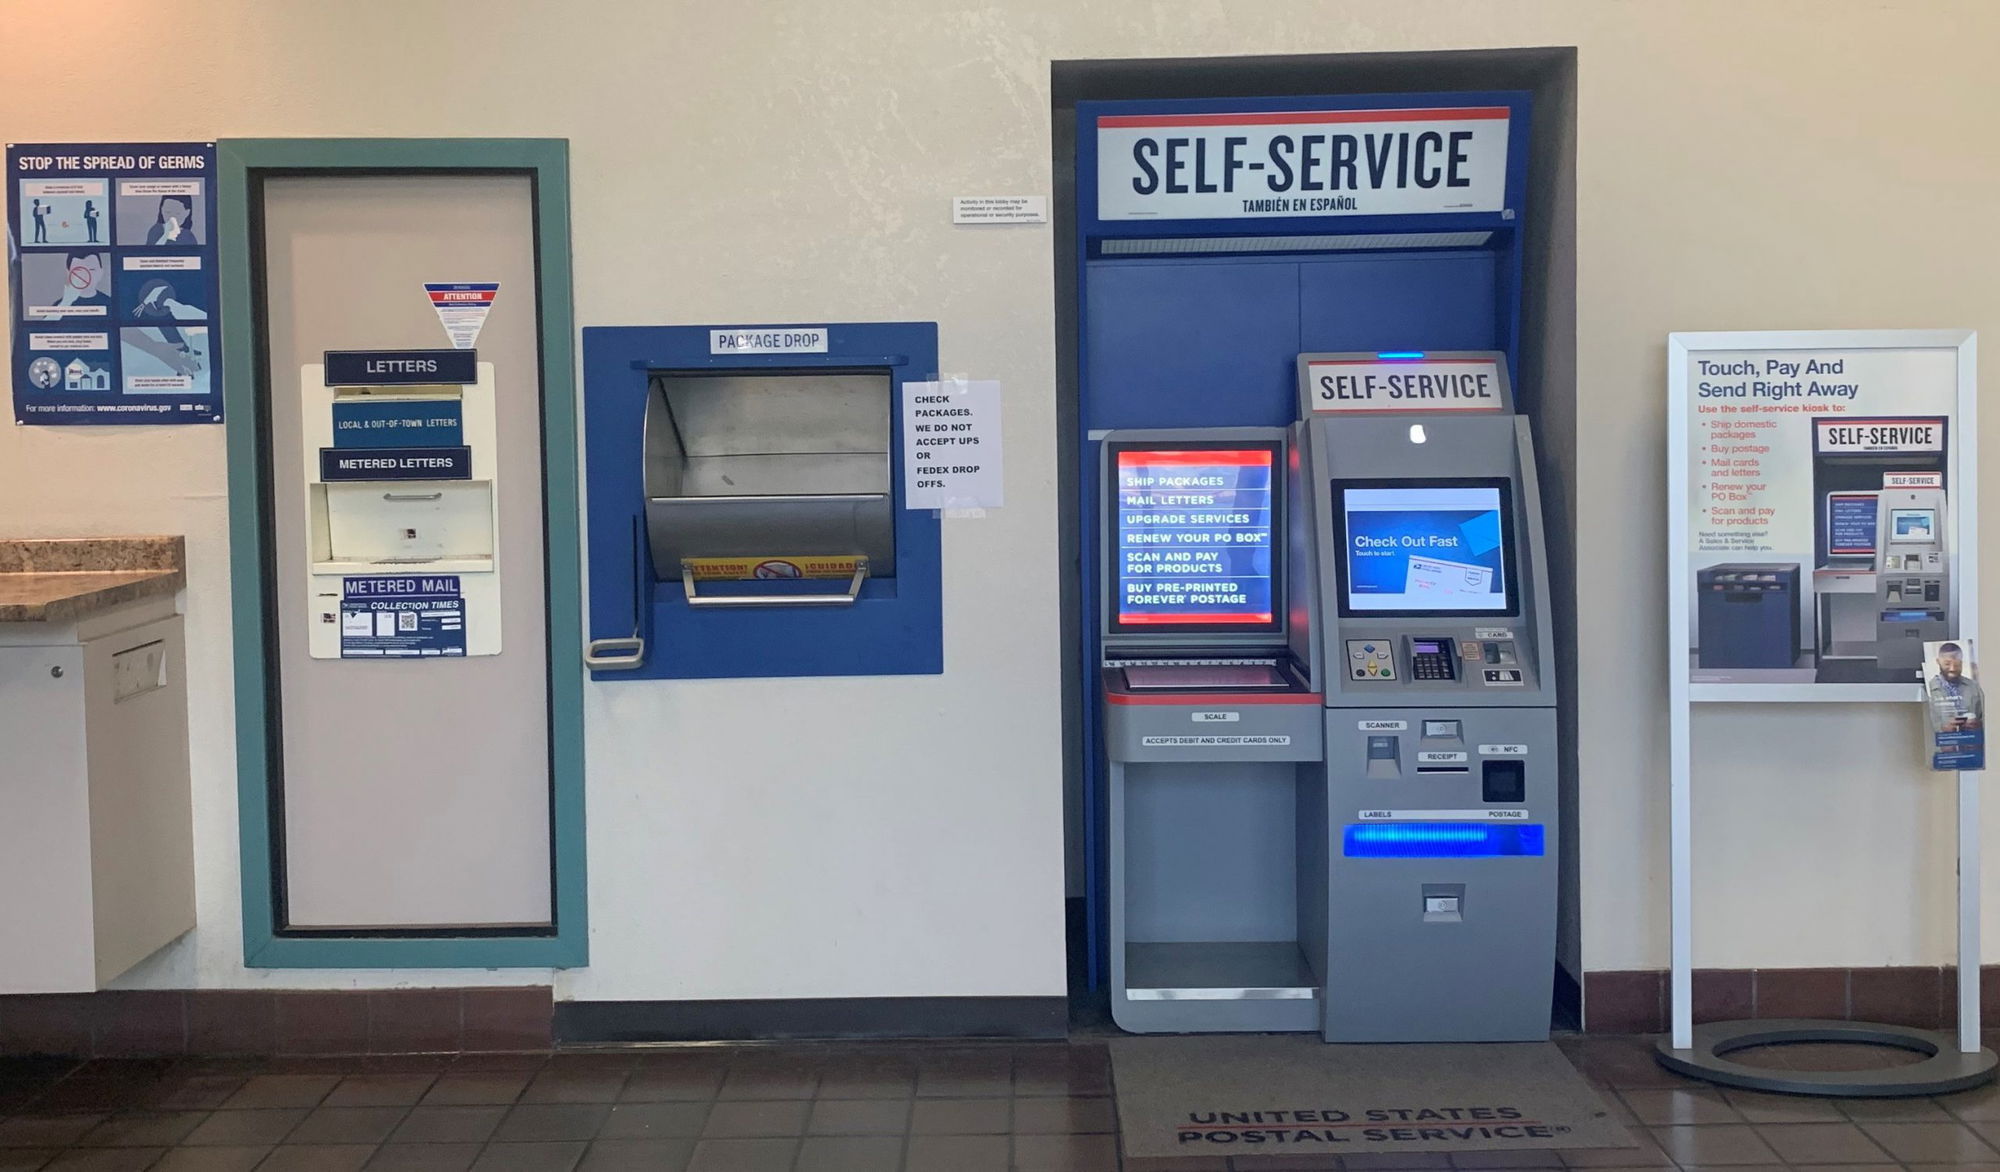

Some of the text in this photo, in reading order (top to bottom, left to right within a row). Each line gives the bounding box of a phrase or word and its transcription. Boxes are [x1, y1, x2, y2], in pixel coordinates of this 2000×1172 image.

[19, 155, 205, 170] STOP THE SPREAD OF GERMS
[1131, 131, 1474, 196] SELF-SERVICE
[1242, 196, 1358, 213] TAMBIÉN EN ESPAÑOL
[443, 292, 483, 300] ATTENTION
[719, 333, 820, 349] PACKAGE DROP
[366, 360, 438, 373] LETTERS
[1698, 359, 1843, 378] Touch, Pay And
[1320, 374, 1491, 401] SELF-SERVICE
[1698, 381, 1859, 400] Send Right Away
[915, 395, 950, 404] CHECK
[57, 404, 96, 412] information:
[96, 404, 172, 413] www.coronavirus.gov
[915, 408, 973, 417] PACKAGES.
[1698, 404, 1846, 413] Use the self-service kiosk to:
[339, 418, 457, 429] LOCAL & OUT-OF-TOWN LETTERS
[934, 424, 948, 432] DO
[1711, 420, 1777, 429] Ship domestic
[1711, 431, 1756, 440] packages
[1829, 427, 1933, 445] SELF-SERVICE
[916, 437, 980, 446] ACCEPT UPS
[1711, 444, 1770, 454] Buy postage
[916, 452, 931, 460] OR
[339, 458, 453, 469] METERED LETTERS
[1733, 458, 1759, 466] cards
[917, 465, 980, 474] FEDEX DROP
[917, 480, 946, 488] OFFS.
[1127, 477, 1224, 486] SHIP PACKAGES
[1892, 476, 1934, 484] SELF-SERVICE
[1712, 482, 1766, 493] Renew your
[1127, 496, 1214, 505] MAIL LETTERS
[1712, 492, 1726, 501] PO
[1712, 506, 1775, 516] Scan and pay
[1127, 514, 1250, 524] UPGRADE SERVICES
[1712, 517, 1768, 526] for products
[1127, 534, 1172, 543] RENEW
[1177, 533, 1210, 543] YOUR
[1214, 533, 1231, 542] PO
[1355, 535, 1458, 548] Check Out Fast
[1127, 552, 1219, 561] SCAN AND PAY
[1127, 564, 1222, 573] FOR PRODUCTS
[346, 579, 458, 594] METERED MAIL
[1127, 583, 1238, 593] BUY PRE-PRINTED
[1191, 594, 1247, 603] POSTAGE
[371, 602, 429, 610] COLLECTION
[432, 601, 459, 609] TIMES
[1189, 1106, 1523, 1125] UNITED STATES
[1177, 1129, 1350, 1145] POSTAL
